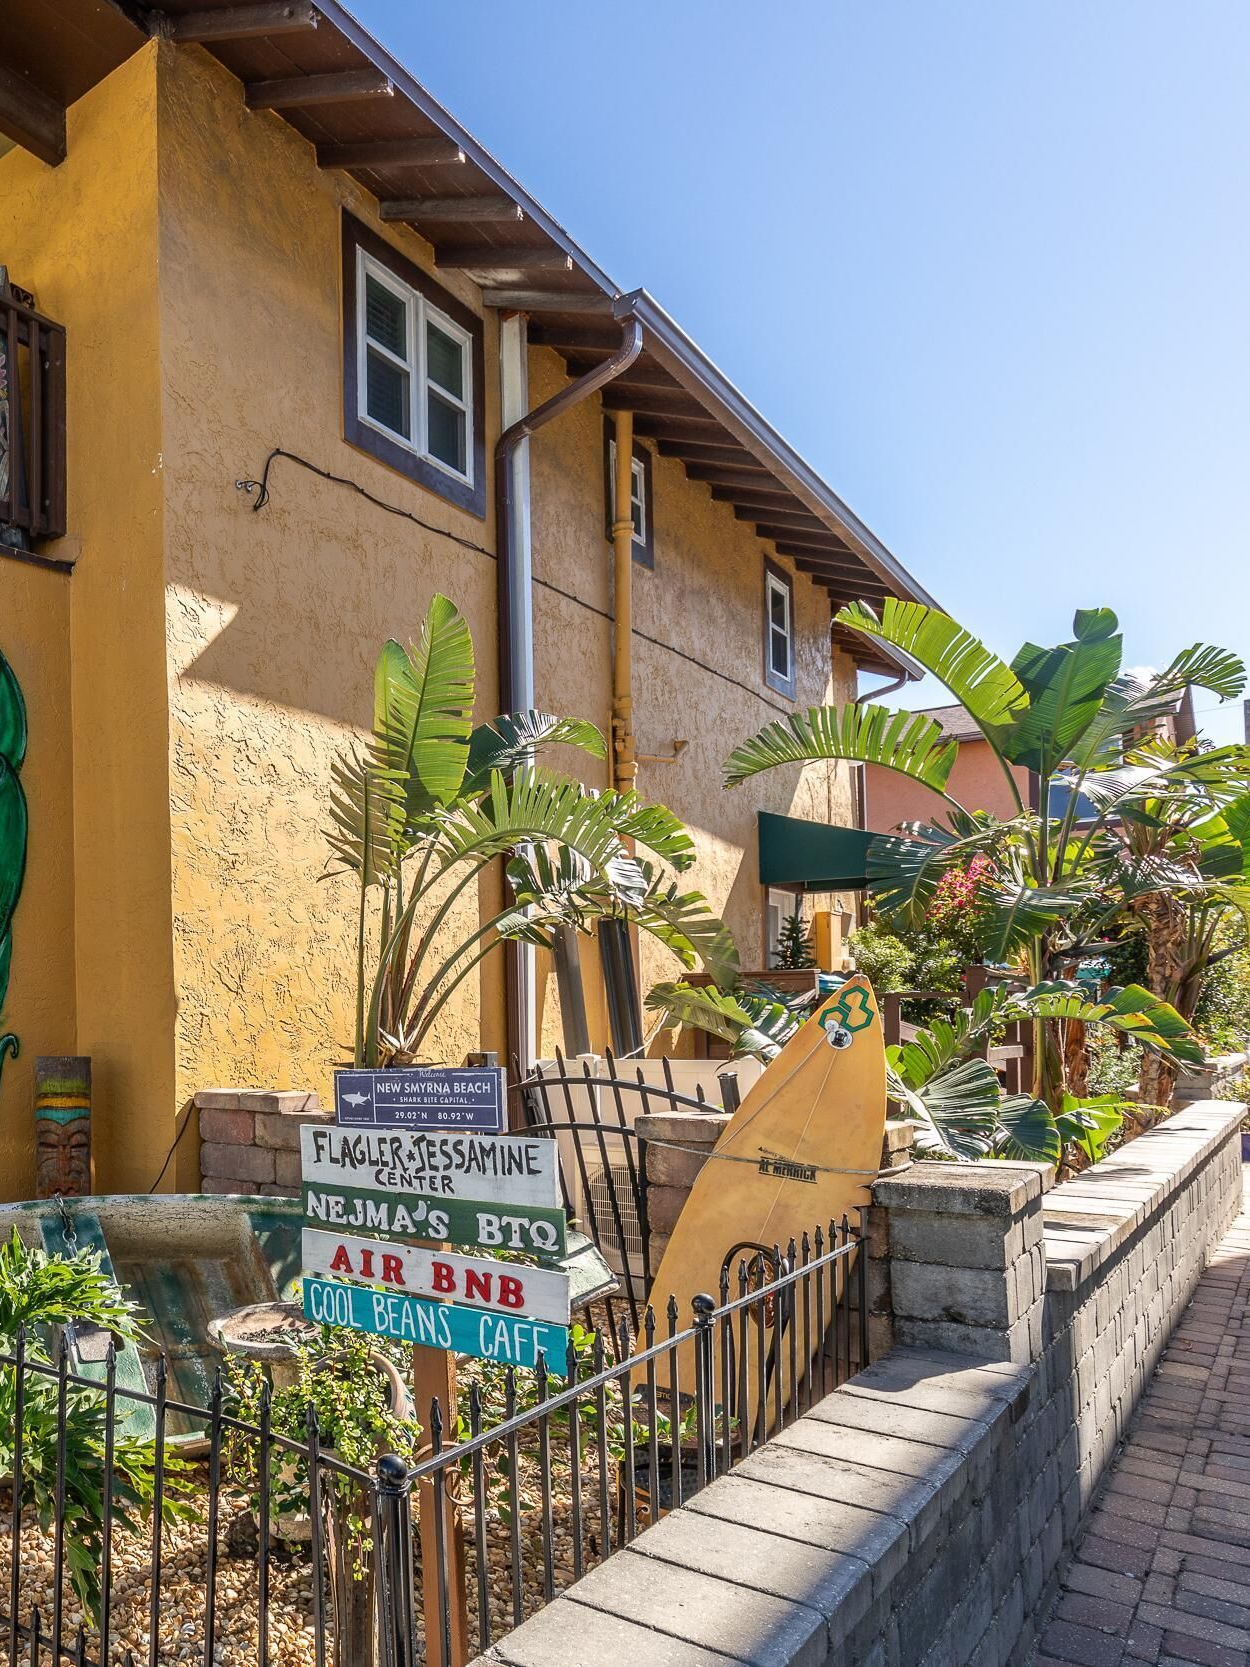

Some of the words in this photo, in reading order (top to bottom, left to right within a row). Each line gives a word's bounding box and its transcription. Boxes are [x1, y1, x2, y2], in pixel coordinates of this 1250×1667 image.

[376, 1082, 401, 1093] NEW
[404, 1082, 451, 1094] SMYRNA
[453, 1082, 491, 1094] BEACH
[418, 1069, 447, 1078] Welcome
[374, 1168, 456, 1195] CENTER
[306, 1189, 450, 1240] NEJMA'S
[475, 1212, 561, 1252] BTQ
[329, 1244, 406, 1286] AIR
[430, 1261, 526, 1309] BNB
[310, 1283, 363, 1328] COOL
[372, 1294, 452, 1349] BEANS
